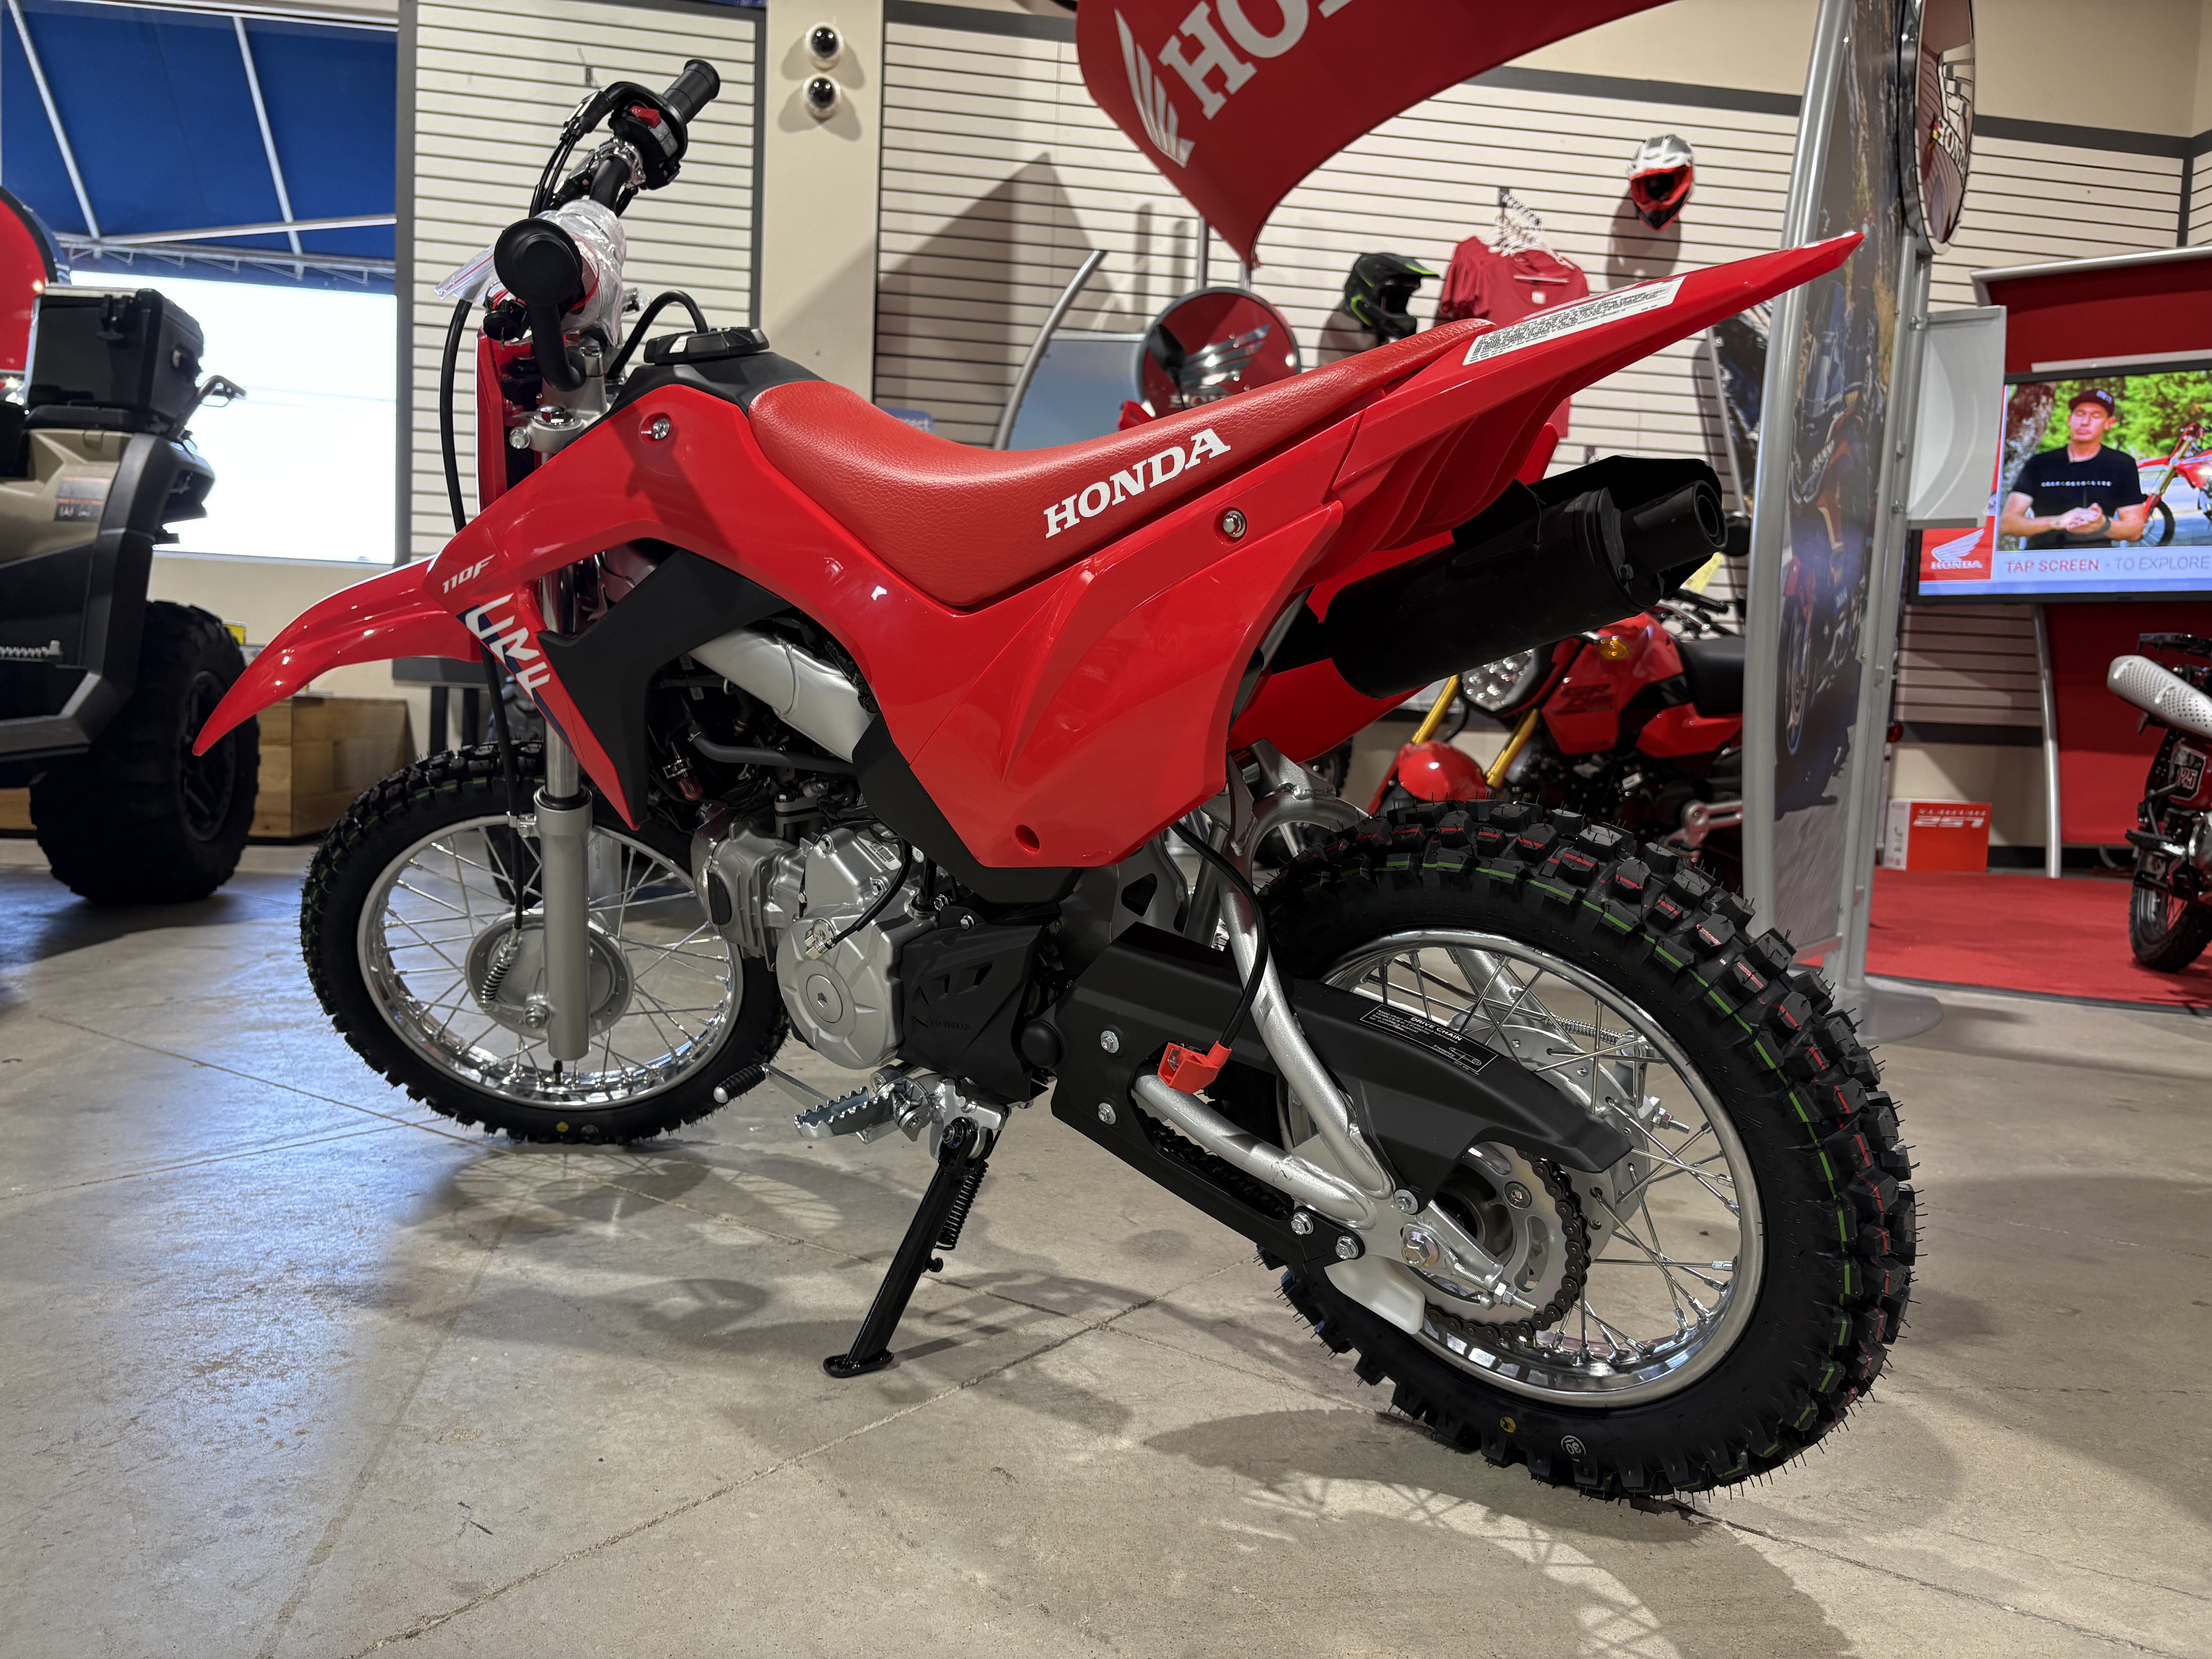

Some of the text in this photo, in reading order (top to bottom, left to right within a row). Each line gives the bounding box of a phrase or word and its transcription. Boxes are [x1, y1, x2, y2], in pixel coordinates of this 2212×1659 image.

[1157, 0, 1353, 120] HO
[1043, 428, 1231, 539] HONDA
[1931, 560, 1983, 569] HONDA
[2006, 556, 2211, 573] TAP SCREEN TO EXPLORE
[443, 554, 496, 594] 110F
[465, 593, 551, 701] CRF
[929, 1019, 971, 1030] HONDA
[1400, 1025, 1419, 1033] manual
[1409, 1024, 1430, 1035] Freeplay
[1410, 1017, 1462, 1041] DRIVE CHAIN
[1434, 1044, 1455, 1057] Freeplay
